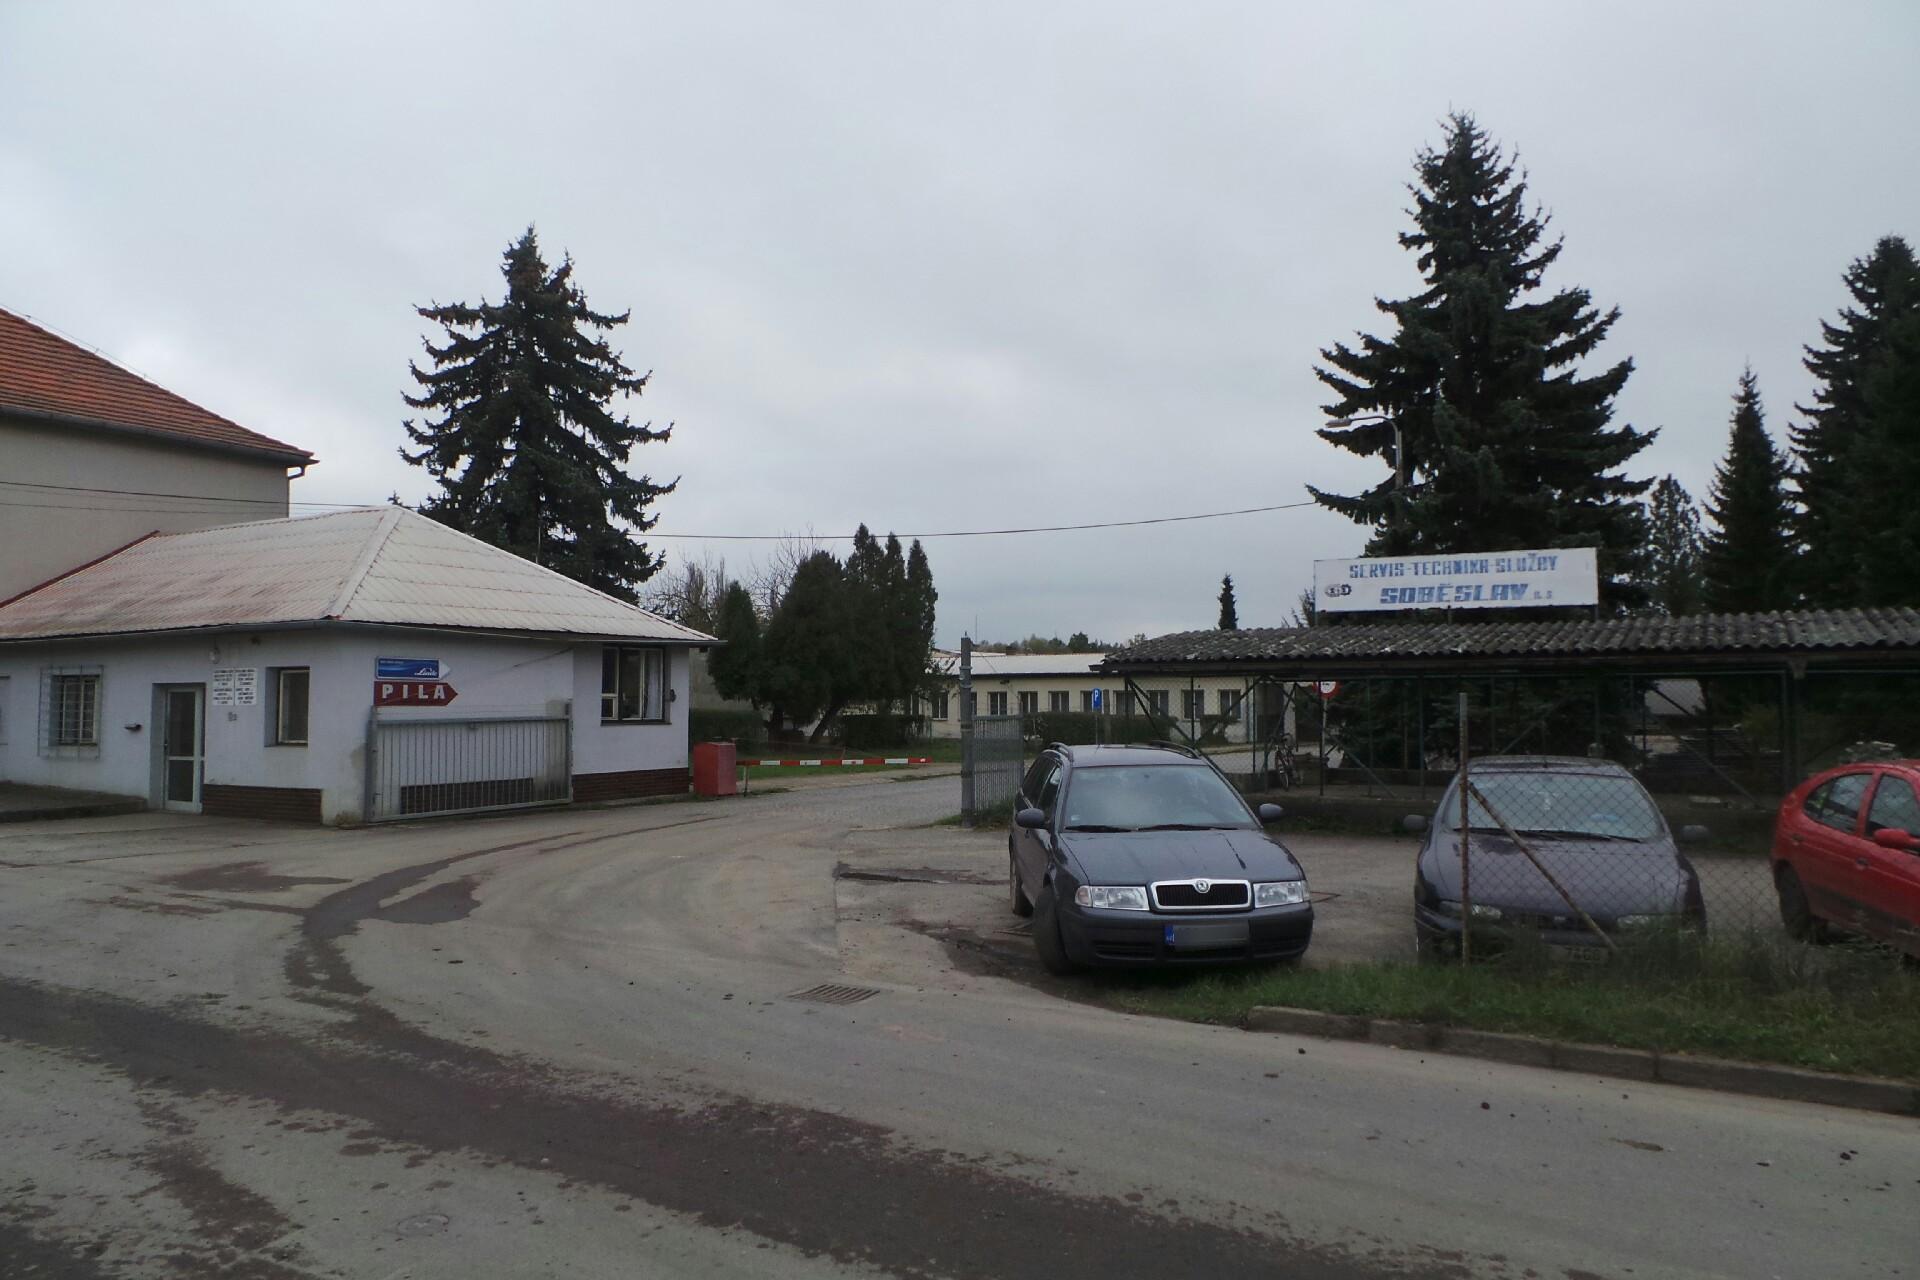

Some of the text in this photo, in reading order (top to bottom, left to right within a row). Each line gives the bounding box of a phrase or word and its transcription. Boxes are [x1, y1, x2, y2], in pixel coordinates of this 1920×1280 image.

[1380, 583, 1529, 604] SOBĚSLAV
[382, 683, 446, 700] PILA
[1094, 689, 1099, 702] P
